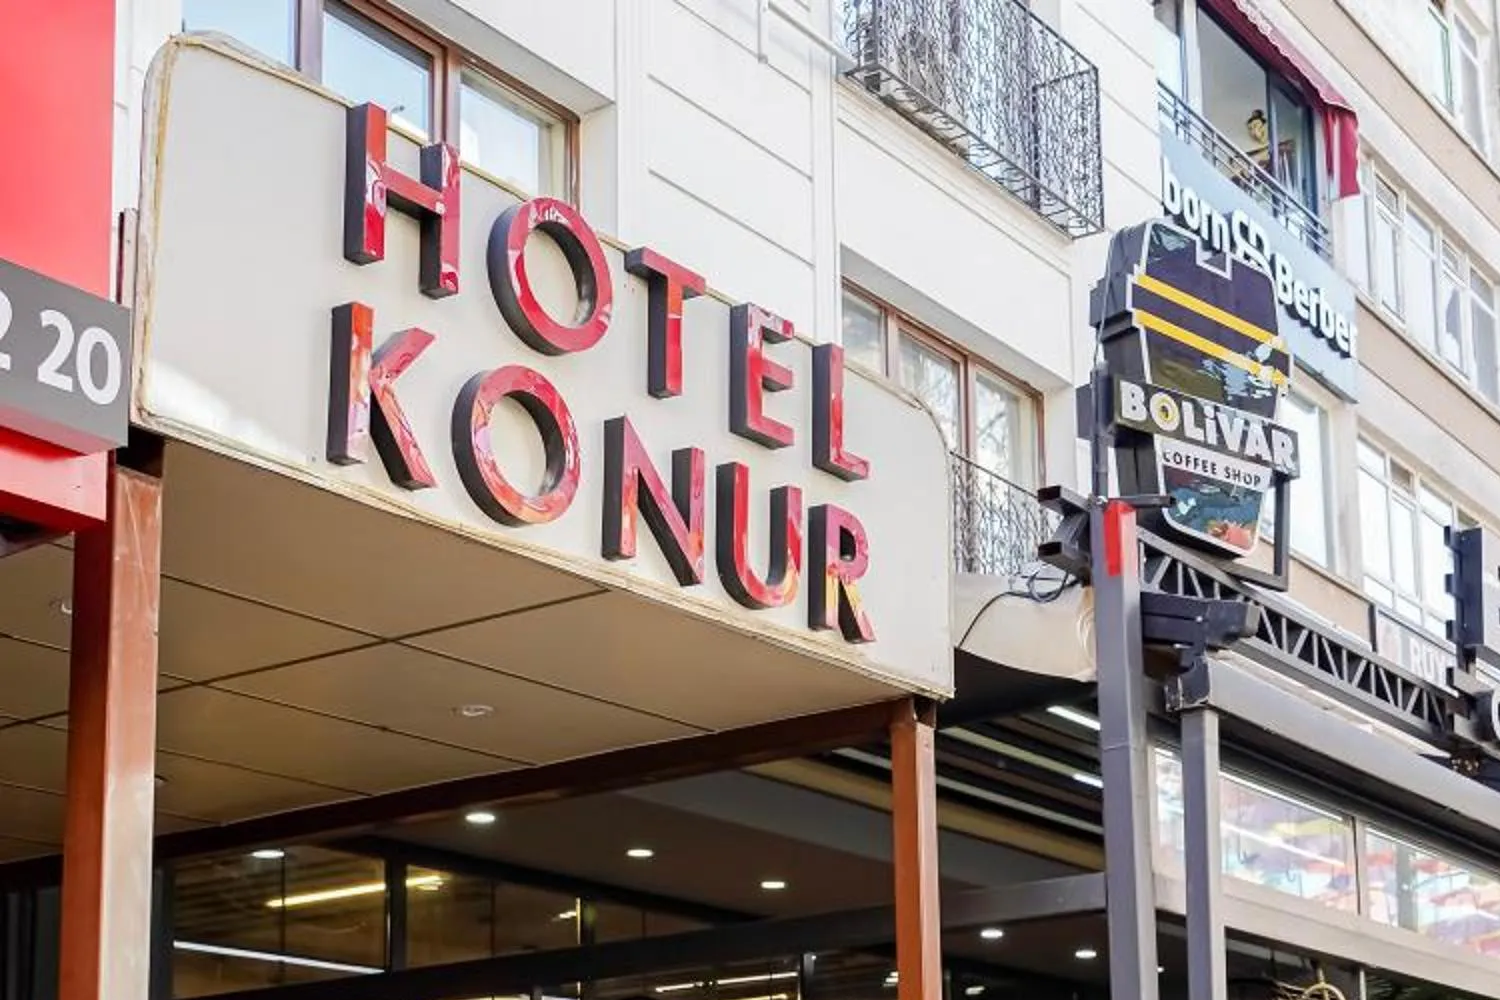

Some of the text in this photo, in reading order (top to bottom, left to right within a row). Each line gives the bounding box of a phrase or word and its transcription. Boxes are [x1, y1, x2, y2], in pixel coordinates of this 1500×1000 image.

[1162, 156, 1231, 254] born
[345, 102, 871, 482] HOTEL
[37, 309, 121, 405] 20
[329, 301, 876, 643] KONUR
[1162, 451, 1261, 487] COFFEE SHOP
